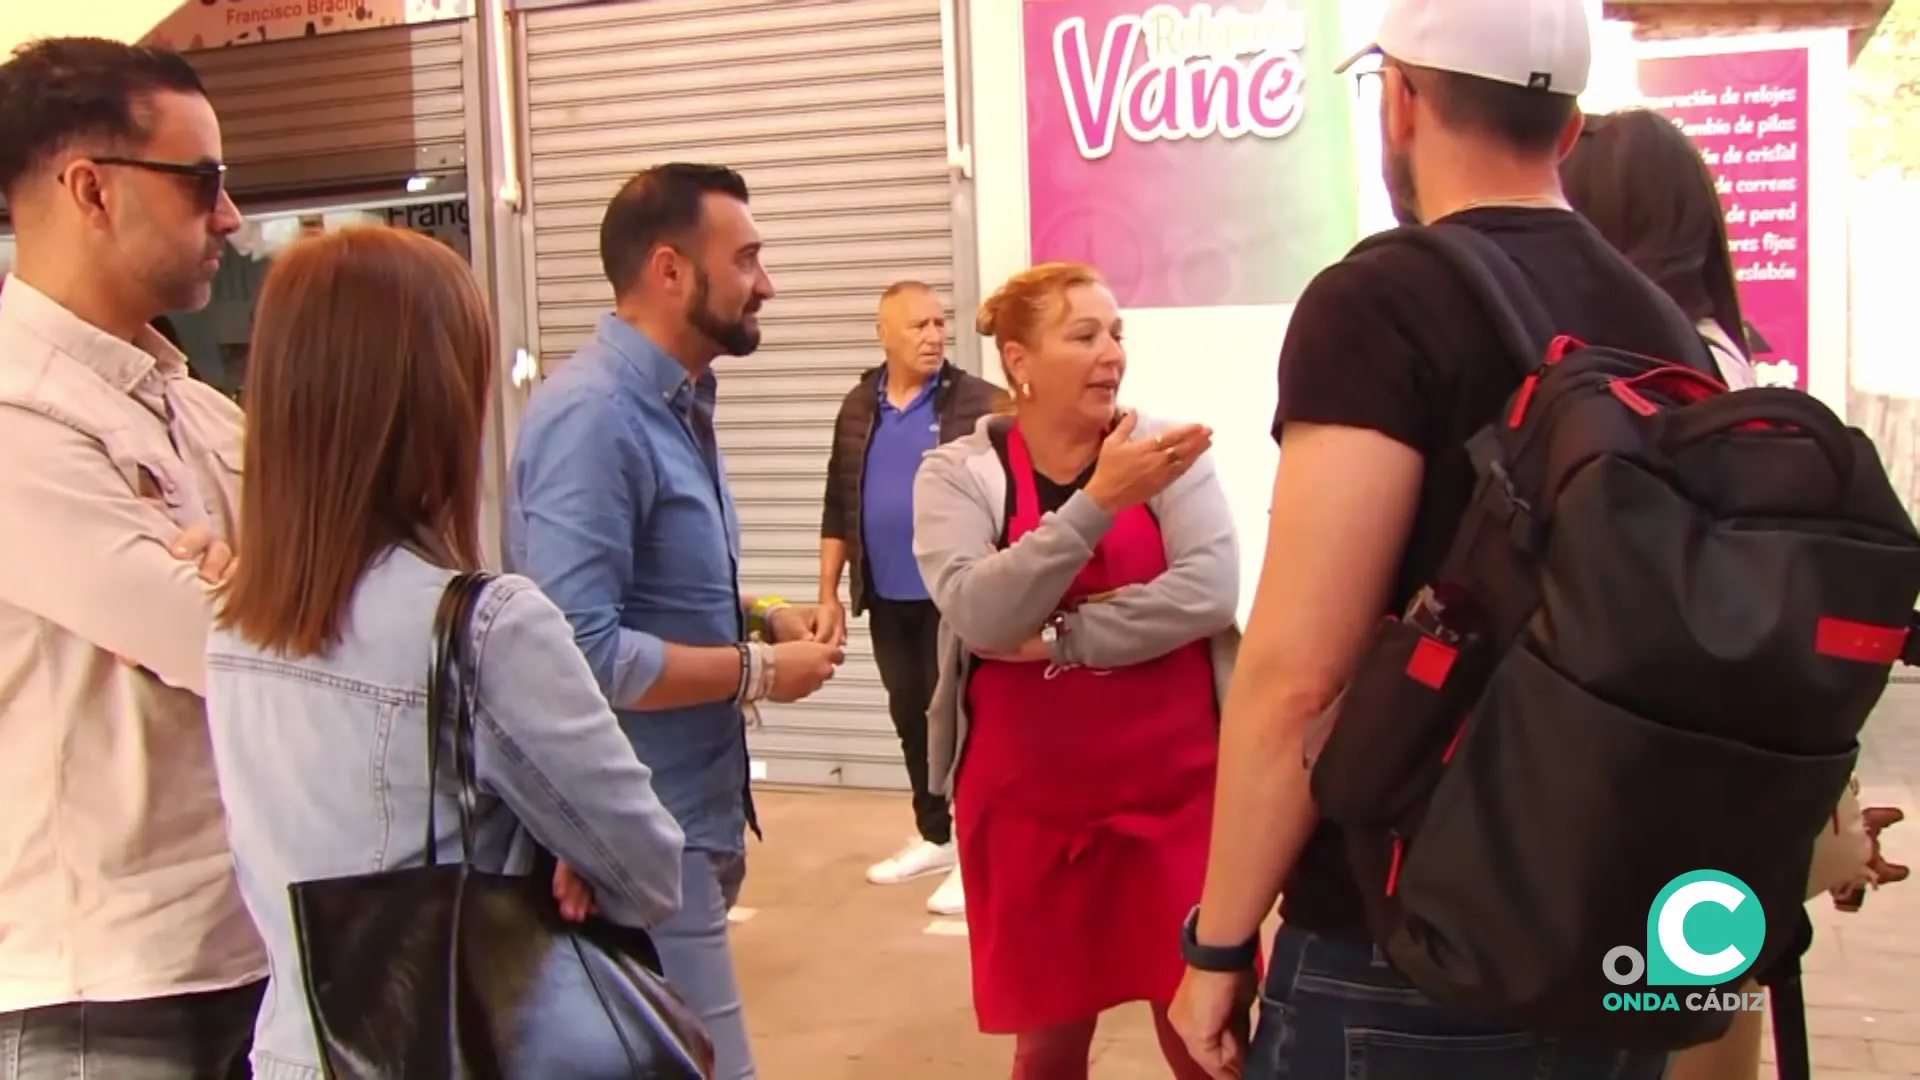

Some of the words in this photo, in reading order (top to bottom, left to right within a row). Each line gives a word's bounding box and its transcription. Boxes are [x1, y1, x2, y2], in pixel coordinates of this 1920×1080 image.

[226, 7, 302, 25] Francisco
[1058, 18, 1299, 155] Vane
[1720, 86, 1740, 104] de
[1744, 84, 1797, 107] relojes
[1734, 115, 1754, 134] de
[1757, 114, 1797, 139] pilas
[1722, 145, 1743, 164] de
[1746, 142, 1797, 163] cristal
[1735, 178, 1797, 192] correas
[1726, 203, 1746, 223] de
[1749, 201, 1797, 228] pared
[1763, 232, 1797, 256] fijos
[1735, 262, 1797, 282] eslabón
